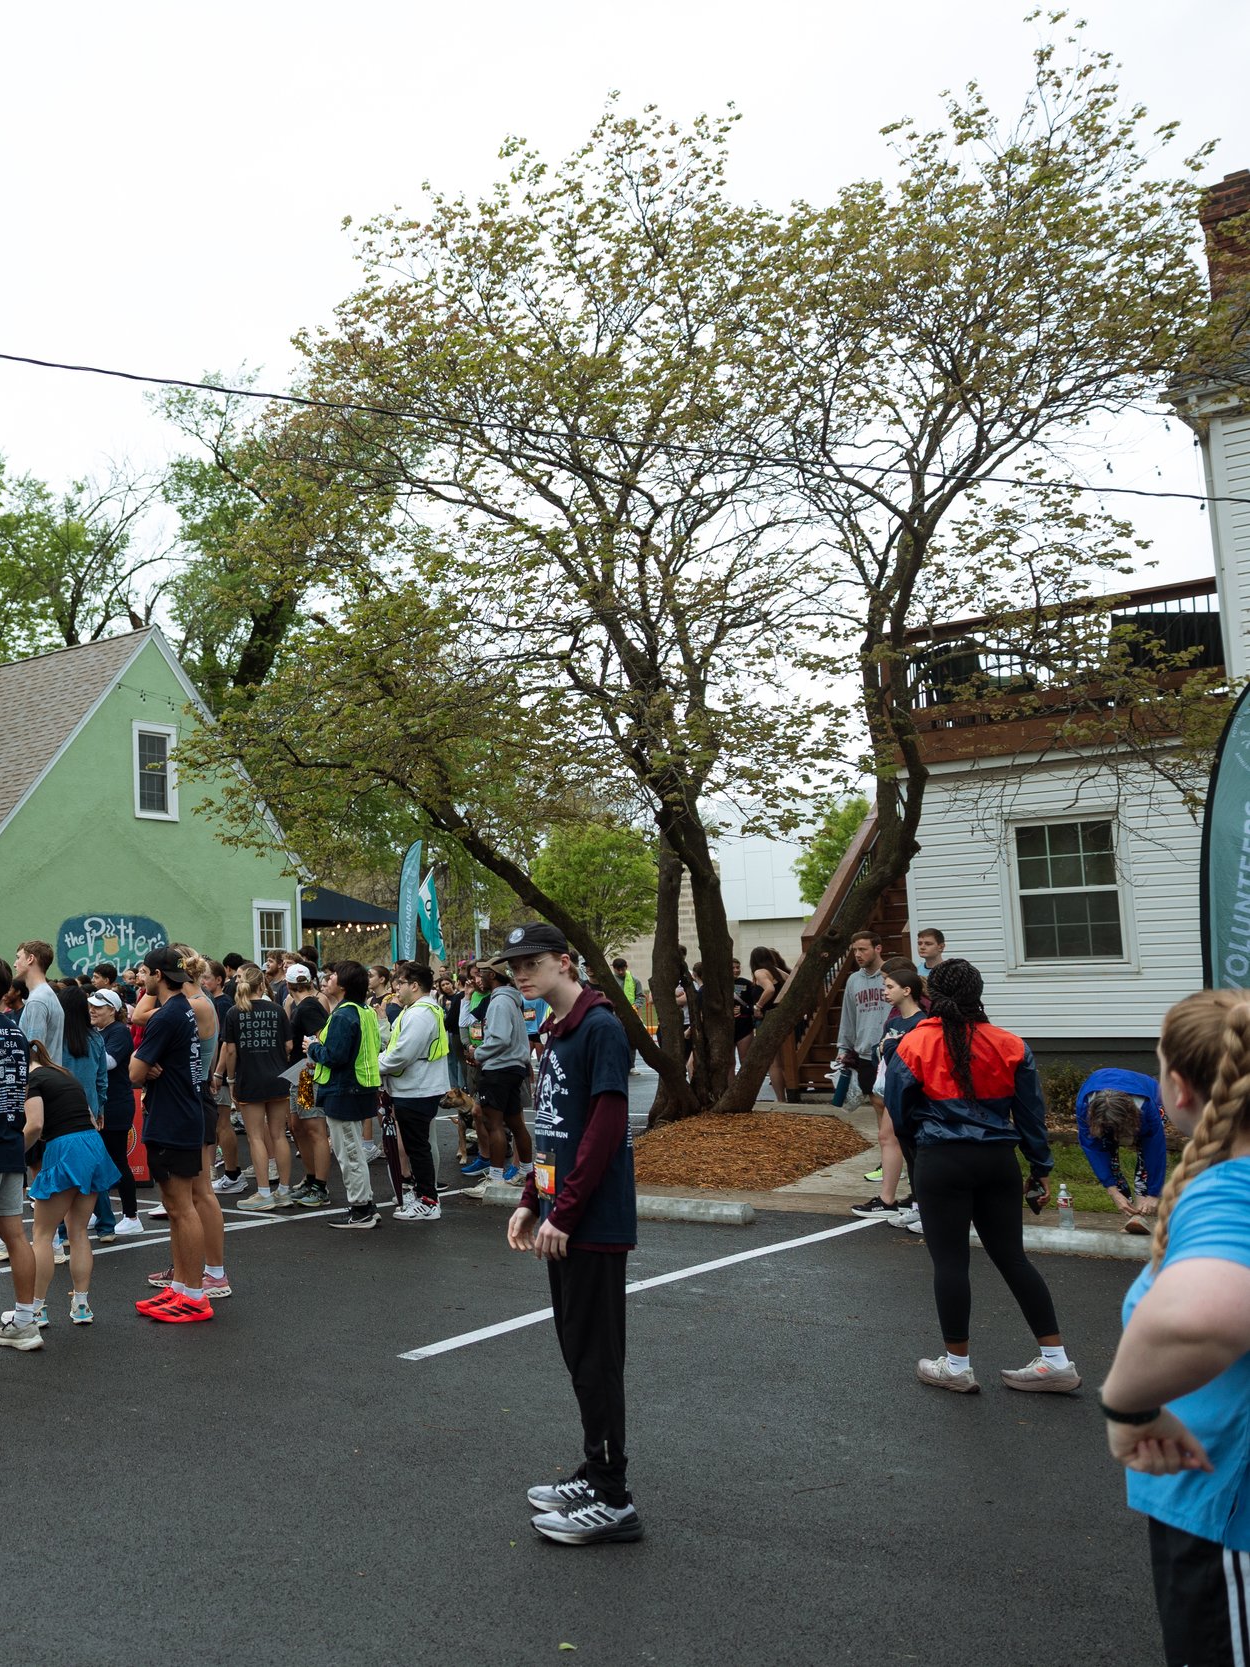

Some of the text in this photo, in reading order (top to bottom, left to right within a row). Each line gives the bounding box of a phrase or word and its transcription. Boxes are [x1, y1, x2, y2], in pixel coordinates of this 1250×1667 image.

[65, 932, 86, 948] the
[855, 988, 886, 1004] EVANGE
[239, 1010, 278, 1020] BE WITH
[239, 1020, 278, 1030] PEOPLE
[240, 1030, 278, 1039] AS SENT
[239, 1039, 277, 1048] PEOPLE
[544, 1129, 556, 1138] FUN
[555, 1130, 569, 1139] RUN
